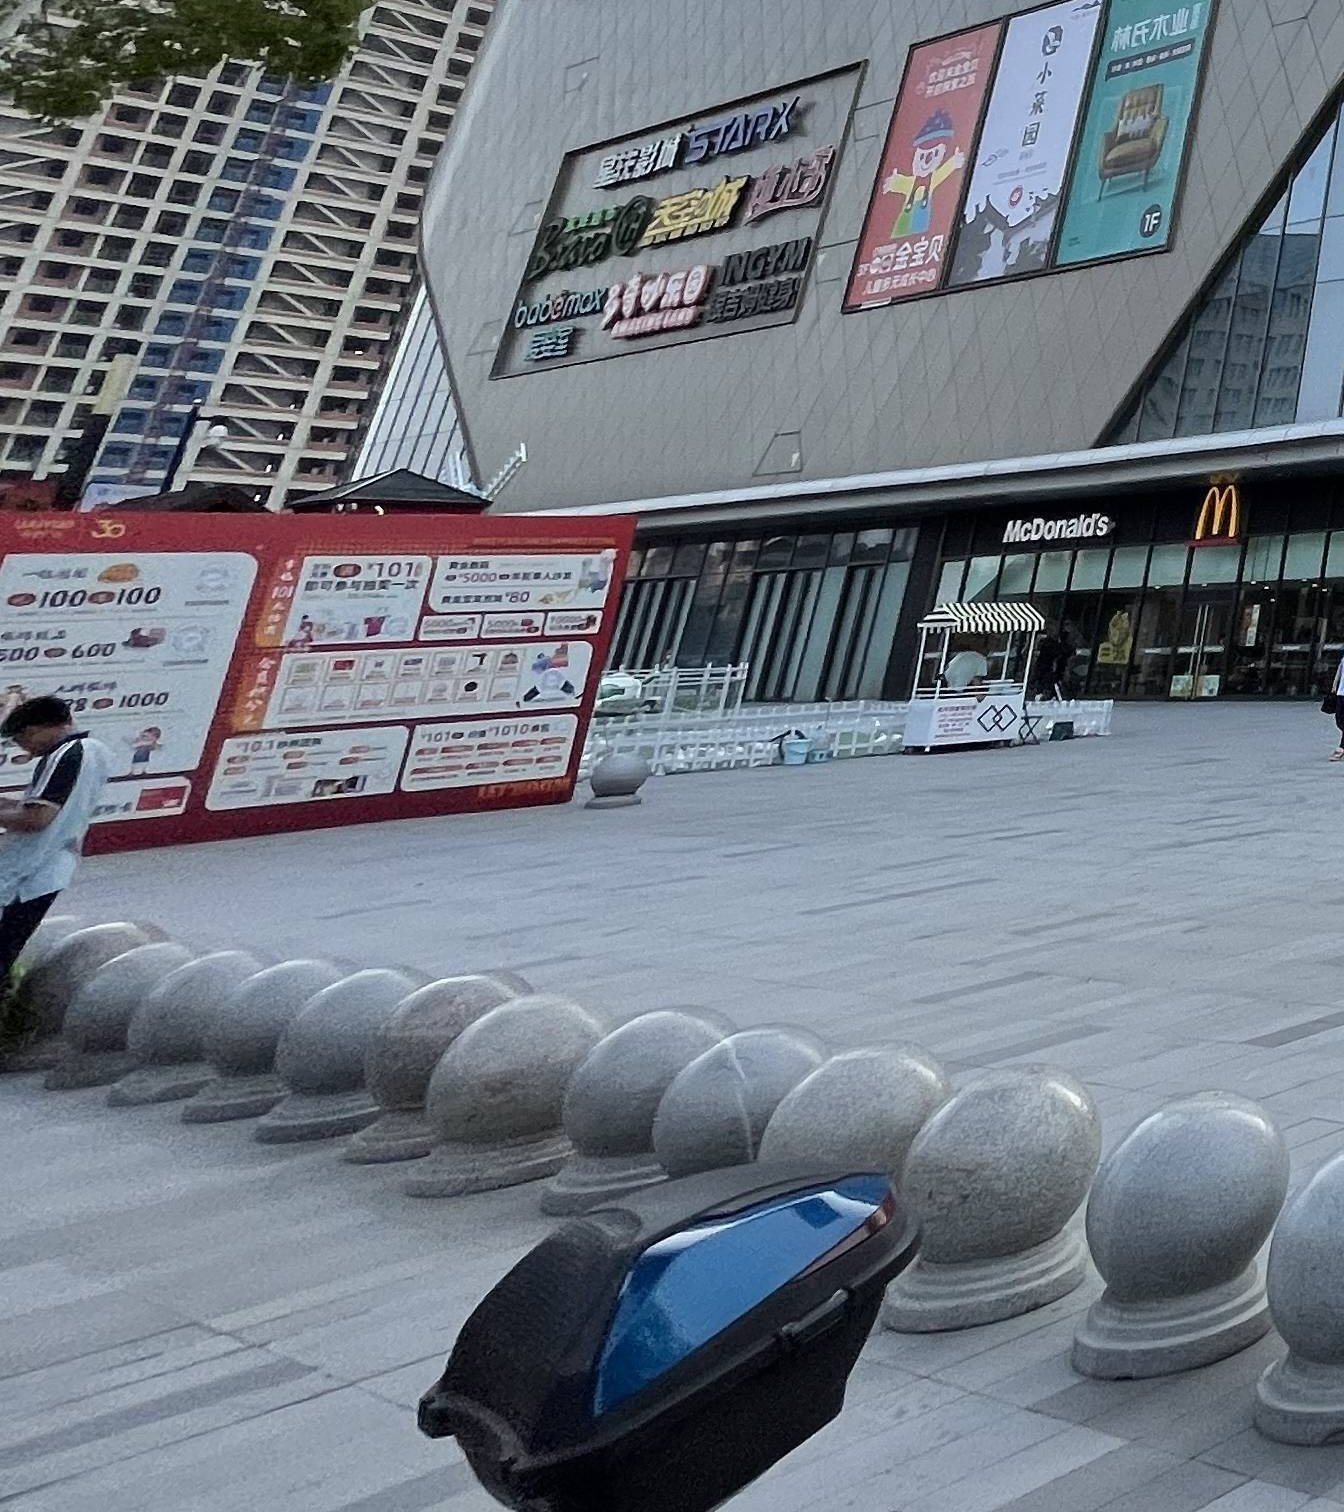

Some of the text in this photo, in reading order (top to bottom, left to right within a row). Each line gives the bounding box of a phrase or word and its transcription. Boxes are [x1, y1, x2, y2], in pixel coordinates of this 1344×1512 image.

[1110, 9, 1189, 52] 林氏木业
[1021, 60, 1053, 148] 小菜园
[684, 96, 801, 164] STARX
[1143, 211, 1159, 233] 1F
[1002, 512, 1111, 544] McDonald's
